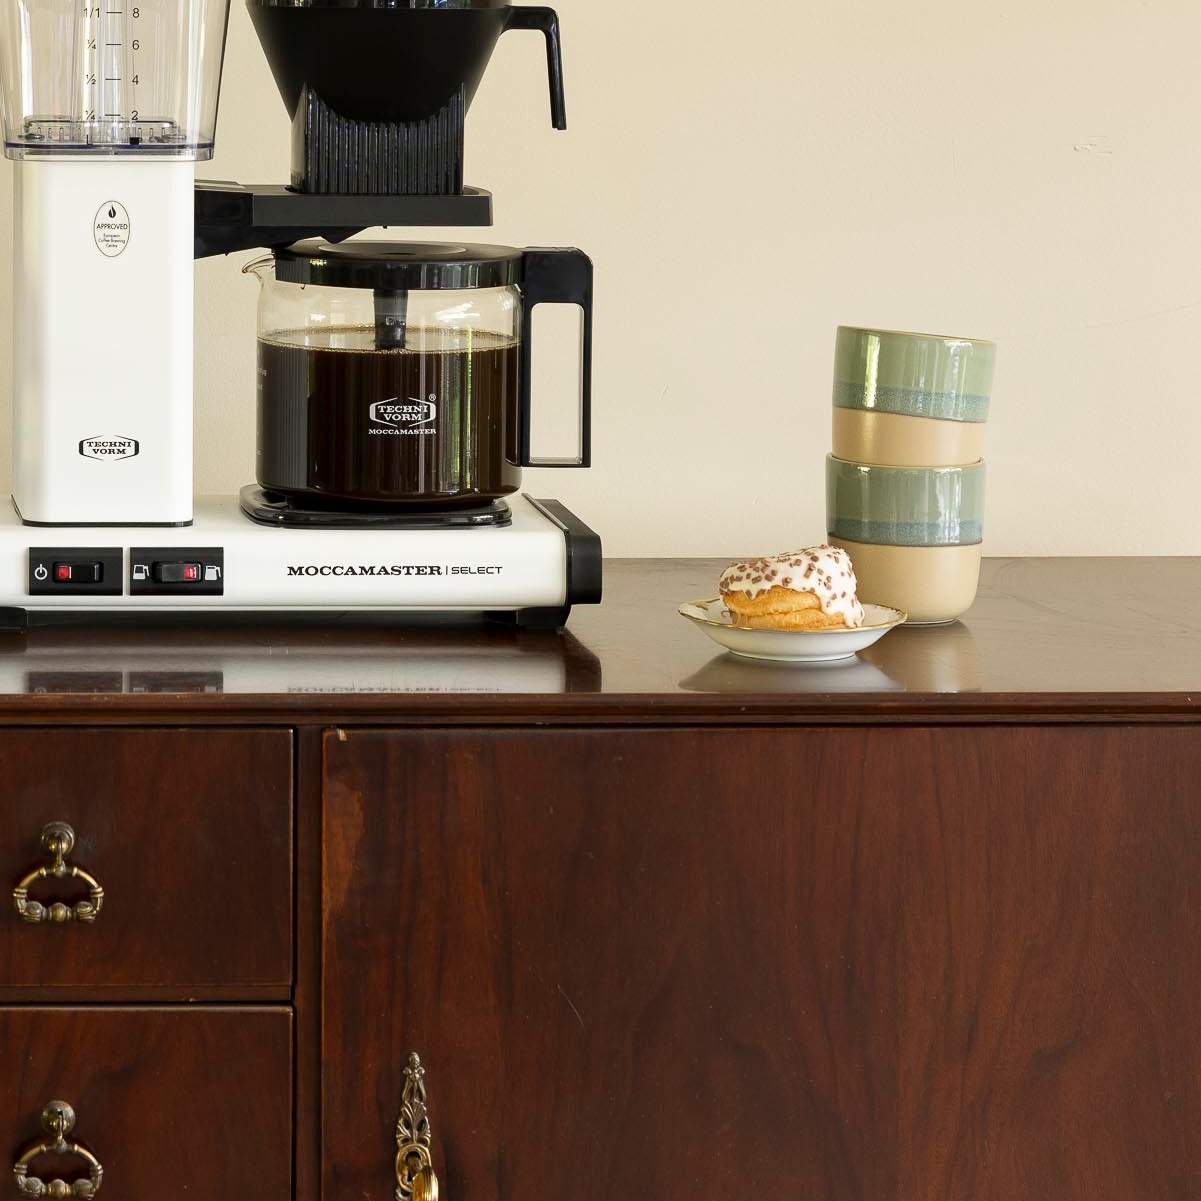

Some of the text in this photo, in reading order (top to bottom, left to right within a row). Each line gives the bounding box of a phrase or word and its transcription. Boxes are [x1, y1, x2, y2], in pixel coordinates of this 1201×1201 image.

[132, 7, 140, 19] 8
[132, 39, 140, 51] 6
[131, 74, 139, 85] 4
[131, 110, 139, 121] 2
[377, 405, 429, 413] TECHNI
[383, 413, 422, 421] VORM
[287, 565, 503, 576] MOCCAMASTER SELECT
